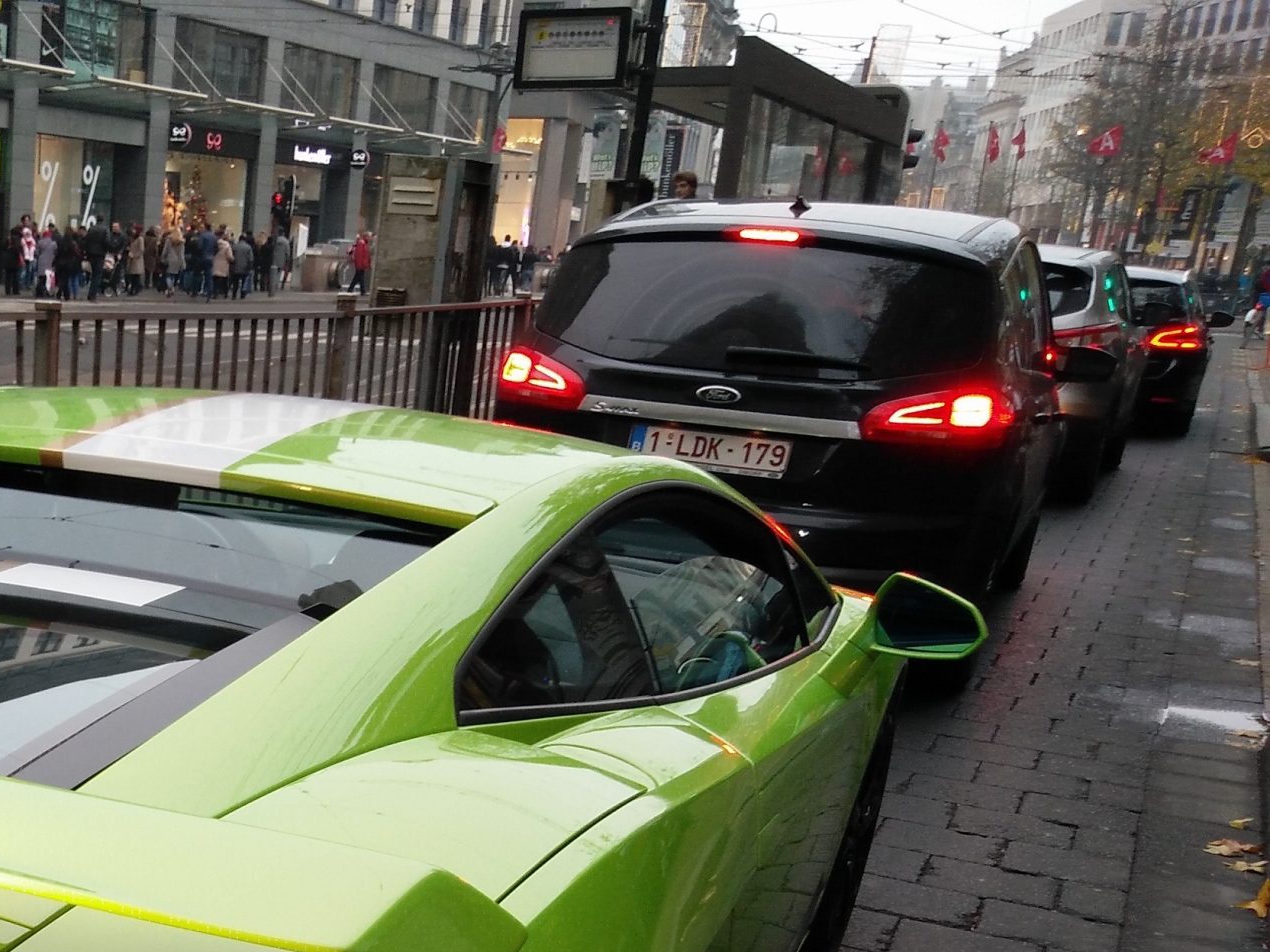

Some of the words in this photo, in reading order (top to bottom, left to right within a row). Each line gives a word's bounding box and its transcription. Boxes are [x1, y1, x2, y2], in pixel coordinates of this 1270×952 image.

[1099, 133, 1115, 152] A
[705, 388, 730, 401] Ford
[631, 440, 642, 450] B
